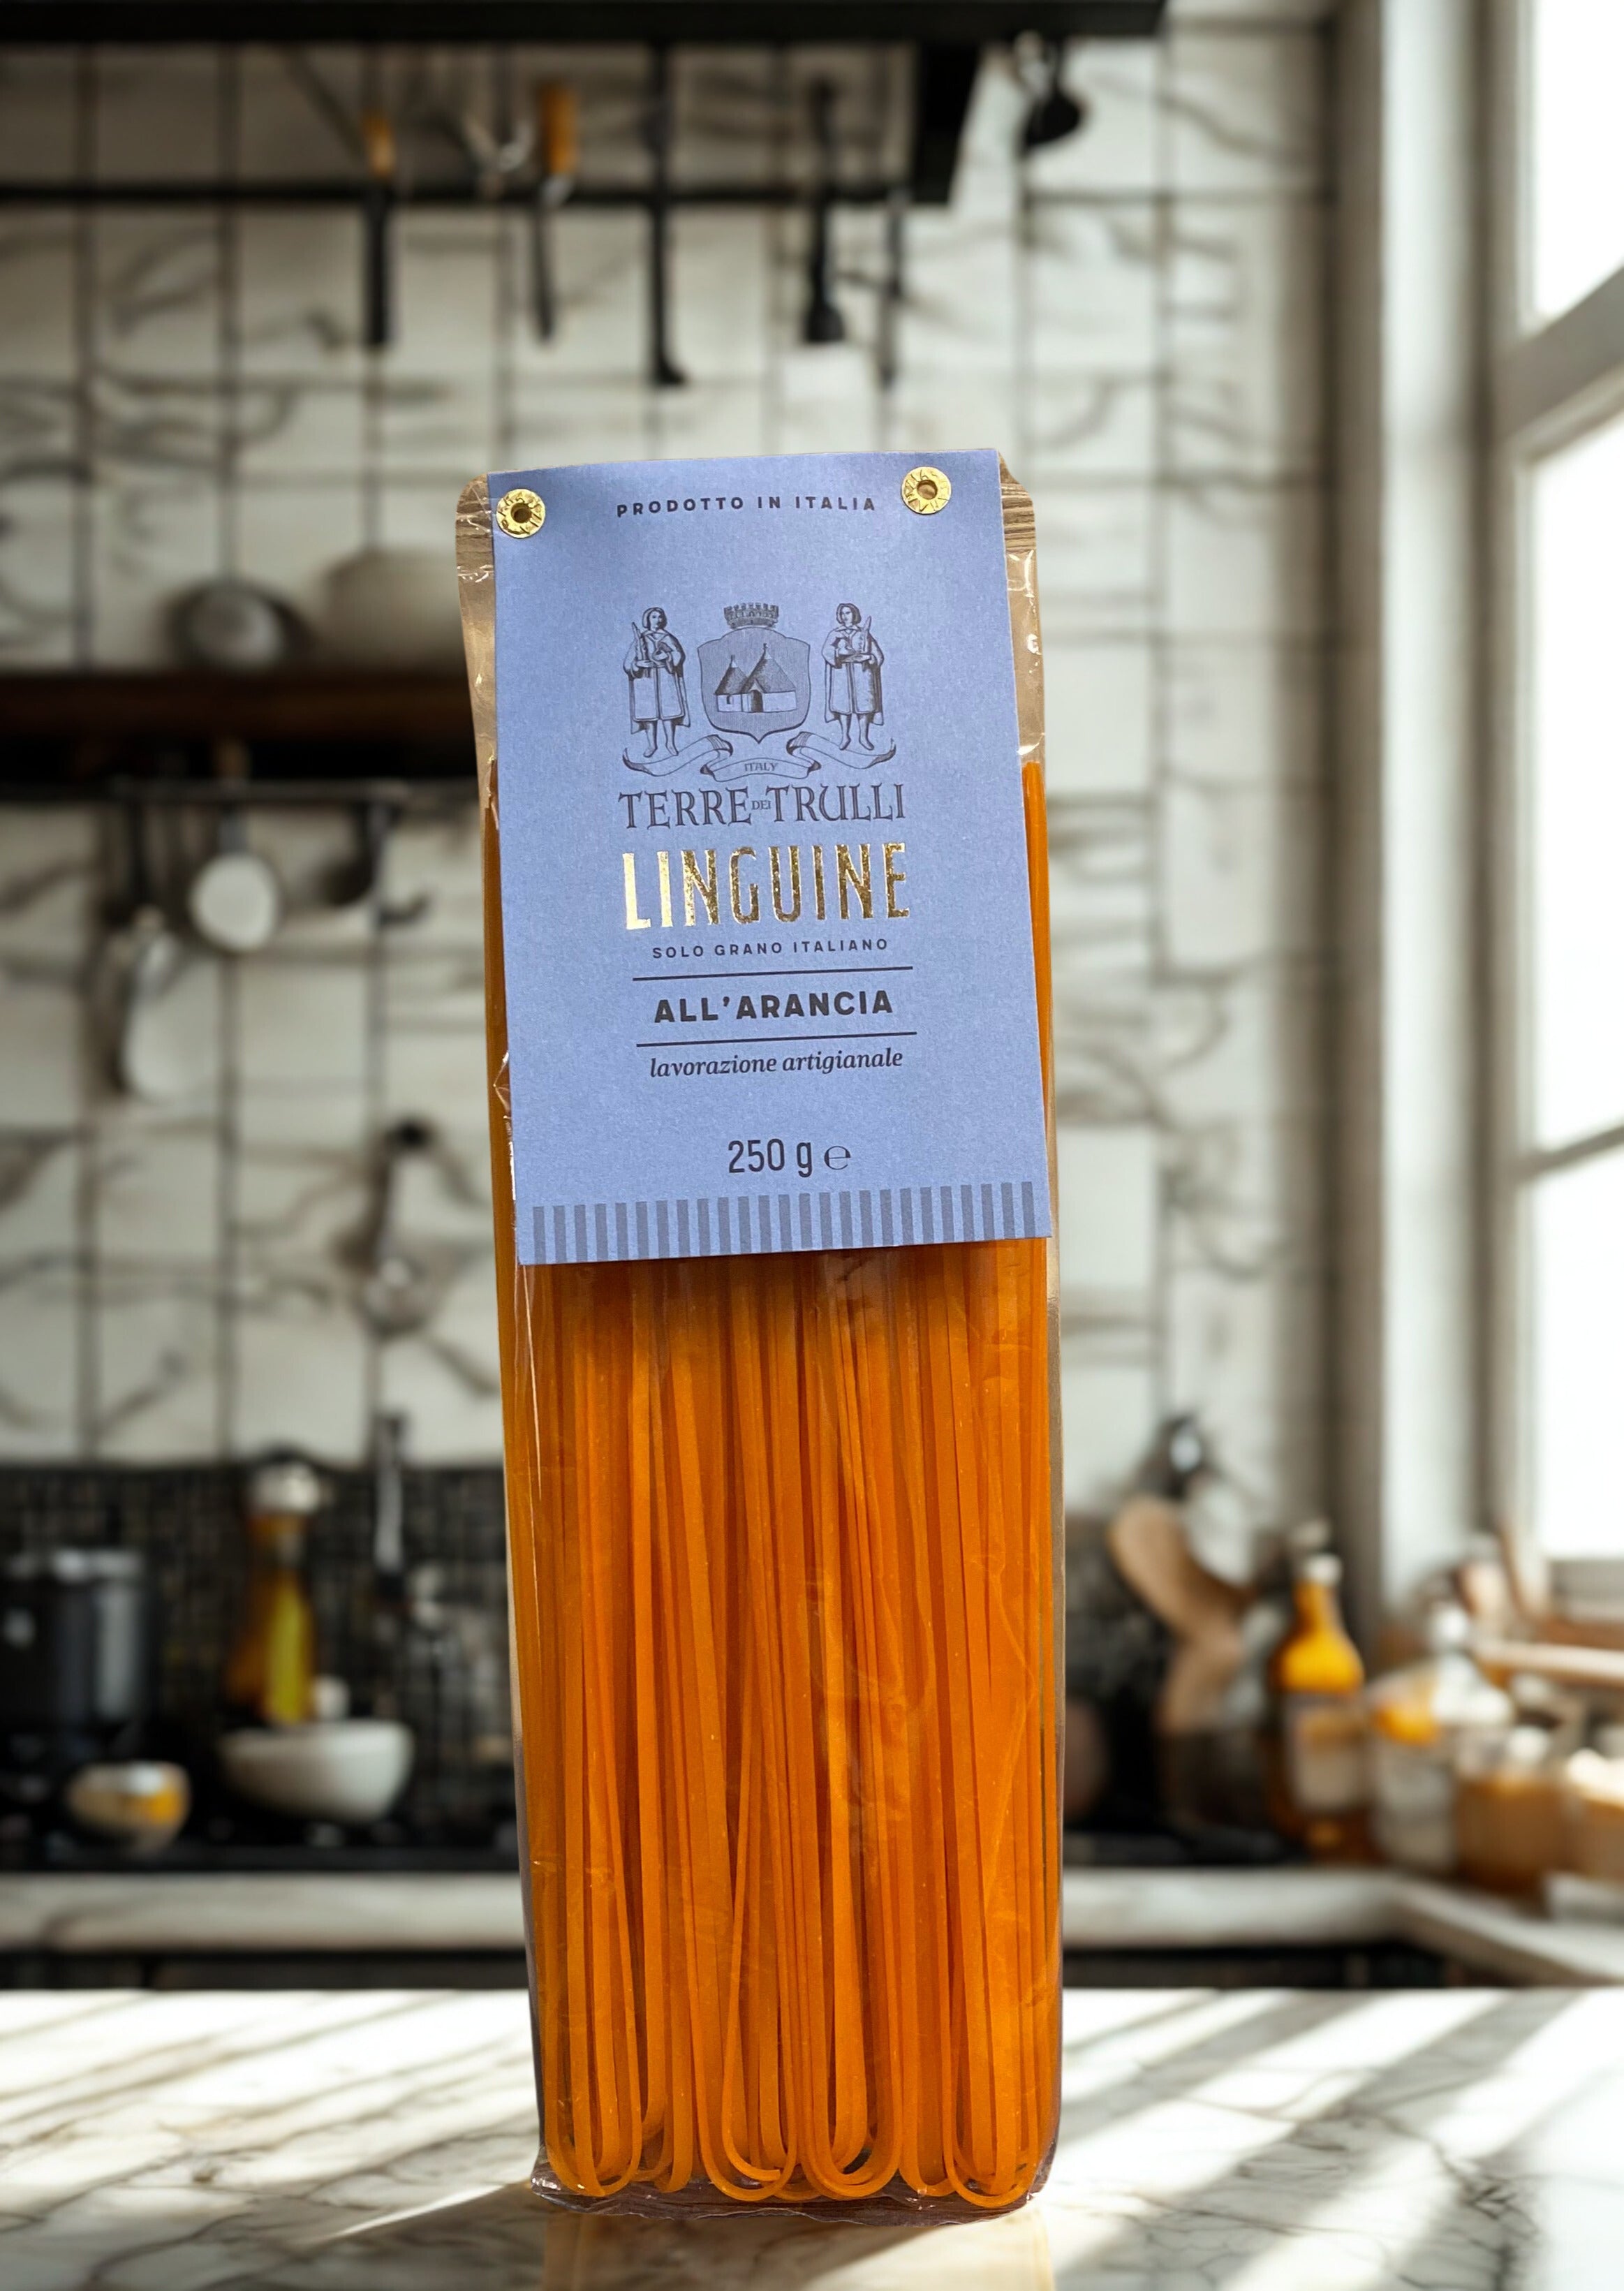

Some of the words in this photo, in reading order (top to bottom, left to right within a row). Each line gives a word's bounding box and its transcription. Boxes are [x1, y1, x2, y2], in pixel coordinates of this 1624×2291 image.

[617, 496, 744, 517] PRODOTTO
[758, 496, 781, 510] IN
[795, 496, 875, 511] ITALIA
[744, 762, 778, 772] ITALY
[619, 786, 751, 830] TERRE
[751, 800, 772, 810] DEI
[766, 783, 906, 822] TRULLI
[622, 842, 910, 930] LINGUINE
[653, 945, 704, 958] SOLO
[715, 942, 782, 955] GRANO
[793, 938, 888, 953] ITALIANO
[654, 990, 893, 1023] ALL'ARANCIA
[650, 1055, 776, 1077] lavorazione
[782, 1048, 903, 1074] artigianale
[728, 1138, 785, 1173] 250
[796, 1141, 813, 1177] g
